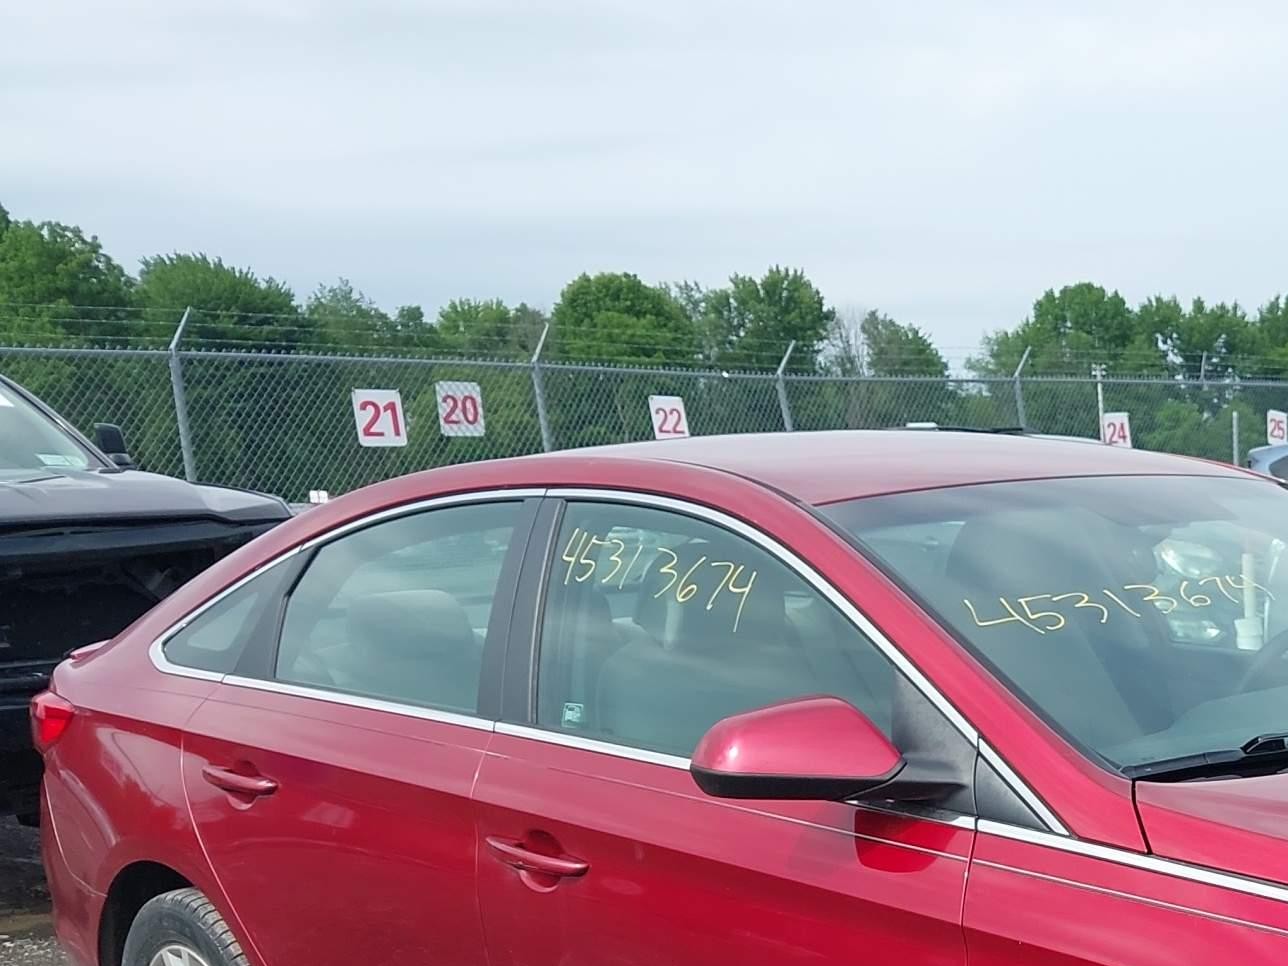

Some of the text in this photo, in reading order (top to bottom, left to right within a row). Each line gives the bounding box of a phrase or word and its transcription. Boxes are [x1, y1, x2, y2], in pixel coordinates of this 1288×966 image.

[359, 400, 401, 437] 21
[442, 394, 479, 425] 20
[655, 407, 685, 434] 22
[1107, 422, 1127, 445] 24
[1270, 418, 1285, 440] 25
[963, 575, 1276, 634] 45313674
